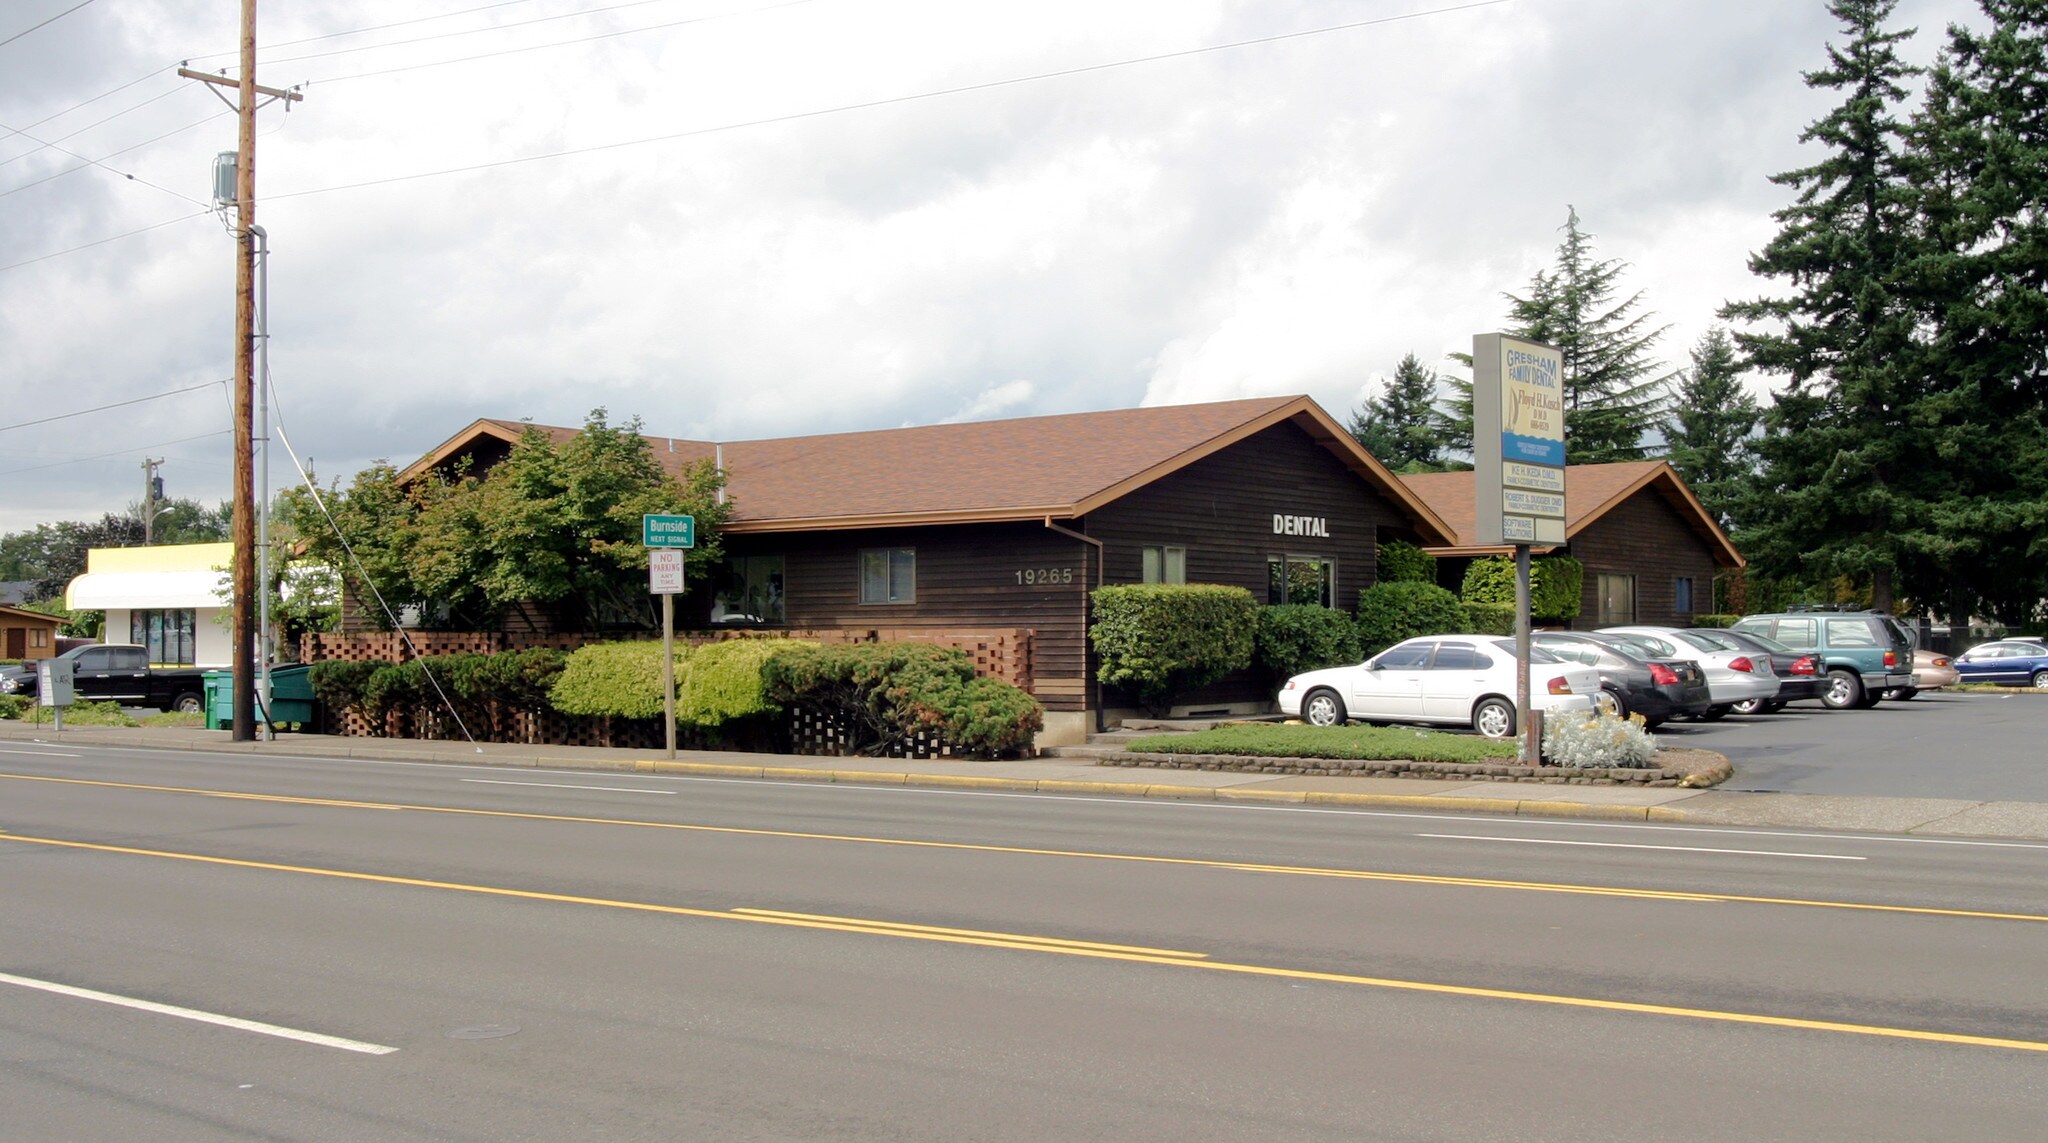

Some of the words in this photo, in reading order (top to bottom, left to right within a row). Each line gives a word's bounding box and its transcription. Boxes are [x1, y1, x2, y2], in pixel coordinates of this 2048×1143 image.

[1507, 349, 1557, 380] GRESHAM
[1509, 365, 1531, 383] FAMILY
[1532, 367, 1555, 388] DENTAL
[1505, 492, 1524, 502] ROBERT
[650, 519, 688, 533] Burnside
[1273, 514, 1330, 538] DENTAL
[1504, 518, 1532, 528] SOFTWARE
[1504, 528, 1532, 538] SOLUTIONS
[650, 535, 665, 543] NEXT
[660, 554, 672, 562] NO
[653, 563, 680, 572] PARKING
[1015, 568, 1073, 585] 19265
